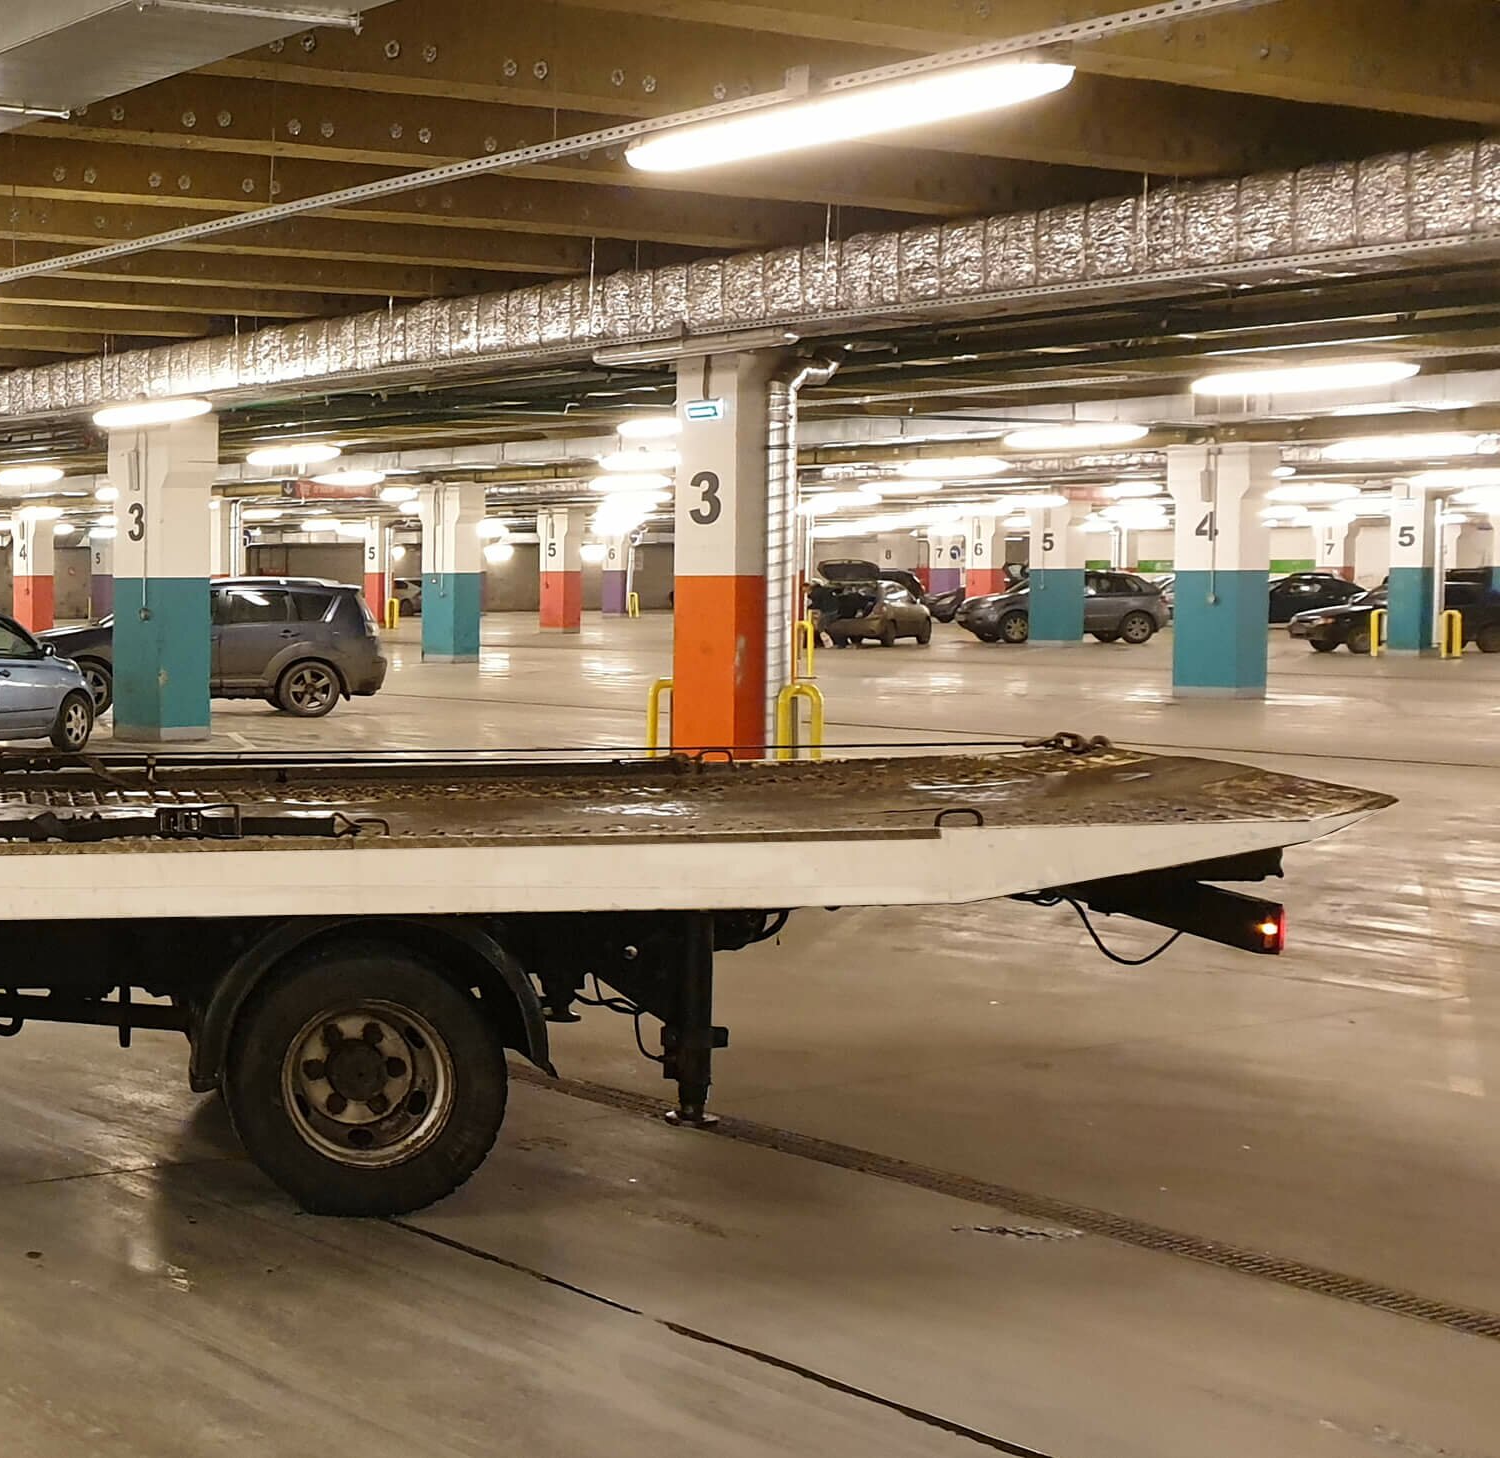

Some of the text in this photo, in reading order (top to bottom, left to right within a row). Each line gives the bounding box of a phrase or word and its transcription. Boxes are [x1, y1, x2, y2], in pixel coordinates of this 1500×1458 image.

[689, 471, 722, 525] 3
[128, 503, 145, 541] 3
[1195, 511, 1219, 541] 4
[1042, 533, 1054, 551] 5
[1398, 526, 1415, 547] 5
[19, 544, 28, 560] 4
[368, 546, 376, 560] 5
[547, 543, 557, 557] 5
[608, 548, 616, 560] 6
[935, 547, 943, 559] 7
[973, 542, 983, 556] 6
[1325, 543, 1334, 555] 7
